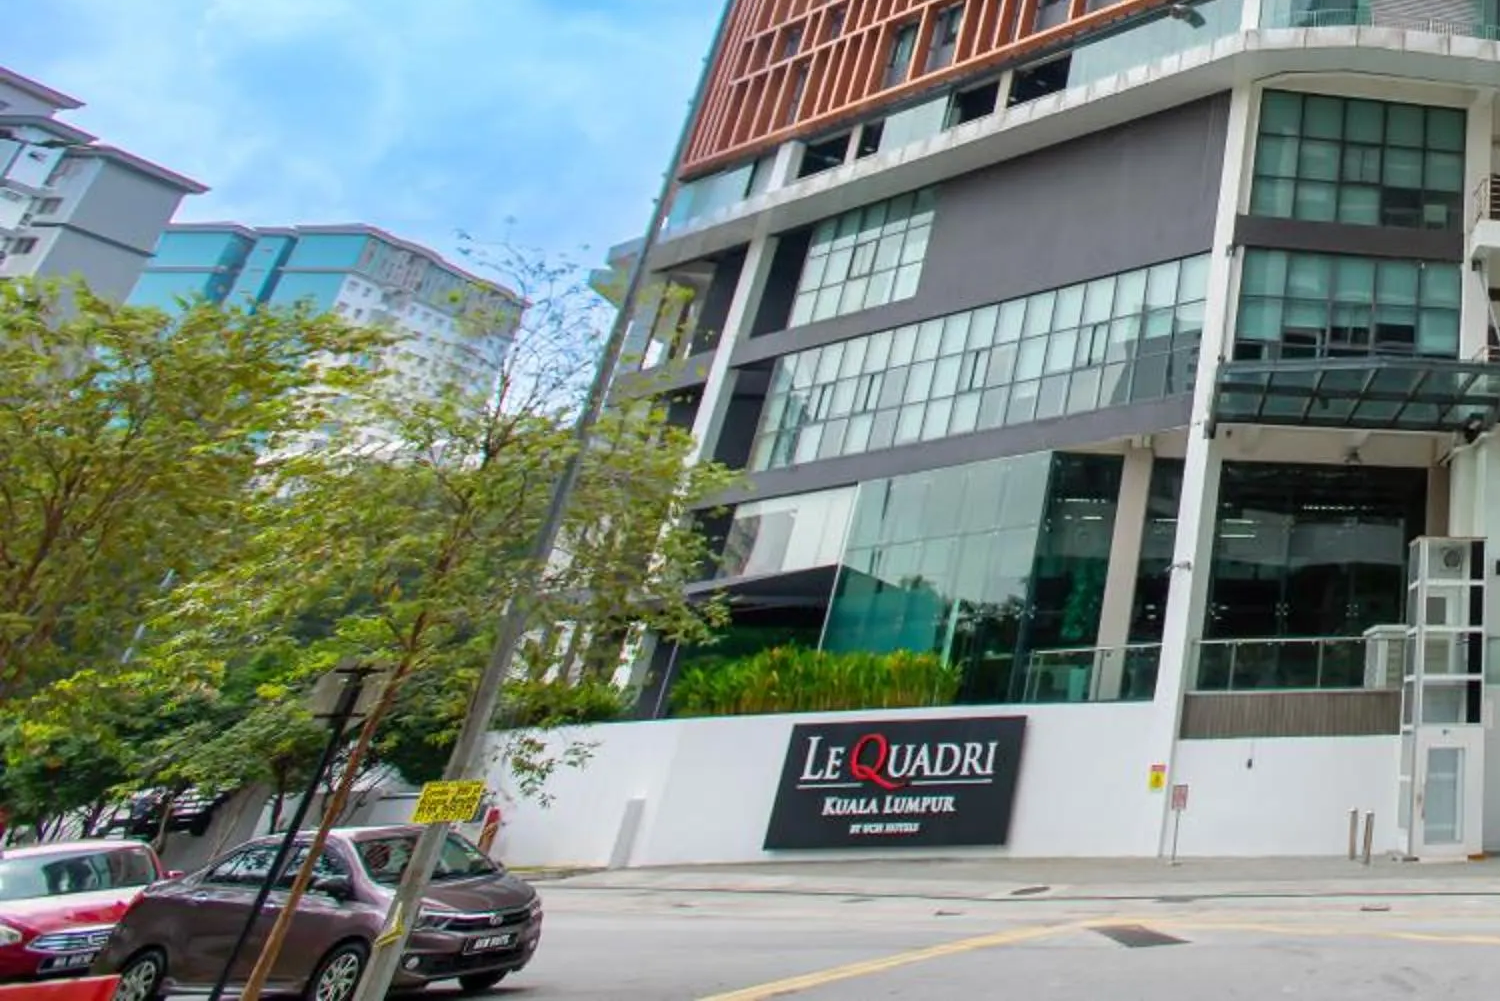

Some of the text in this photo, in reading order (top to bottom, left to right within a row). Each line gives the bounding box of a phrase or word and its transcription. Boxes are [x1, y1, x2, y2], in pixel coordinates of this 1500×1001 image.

[800, 733, 998, 789] LE QUADRI
[822, 795, 955, 815] KUALA LUMPUR
